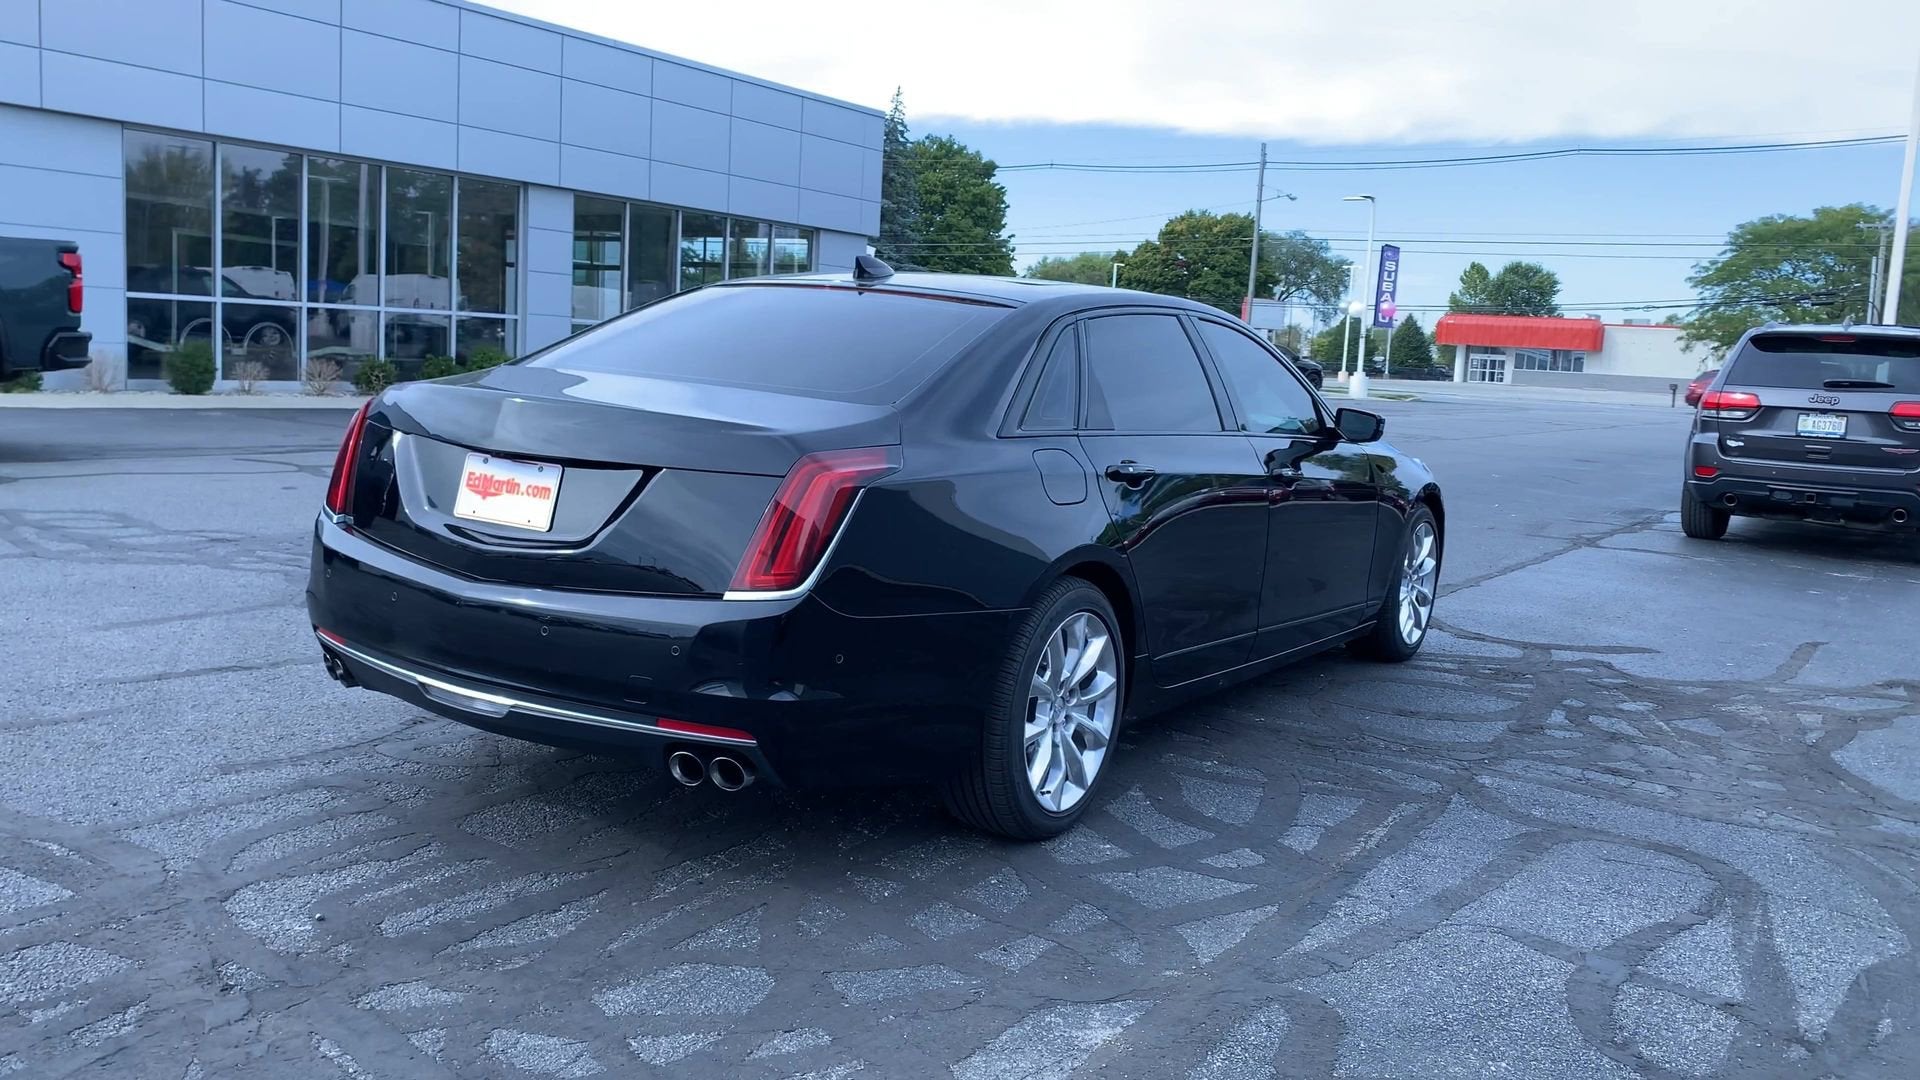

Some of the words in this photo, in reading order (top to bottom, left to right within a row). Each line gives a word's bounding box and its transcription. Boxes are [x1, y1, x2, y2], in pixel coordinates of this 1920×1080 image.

[1378, 261, 1396, 323] SUBAU
[1808, 393, 1840, 406] Jeep
[465, 471, 552, 500] EdMartin.com
